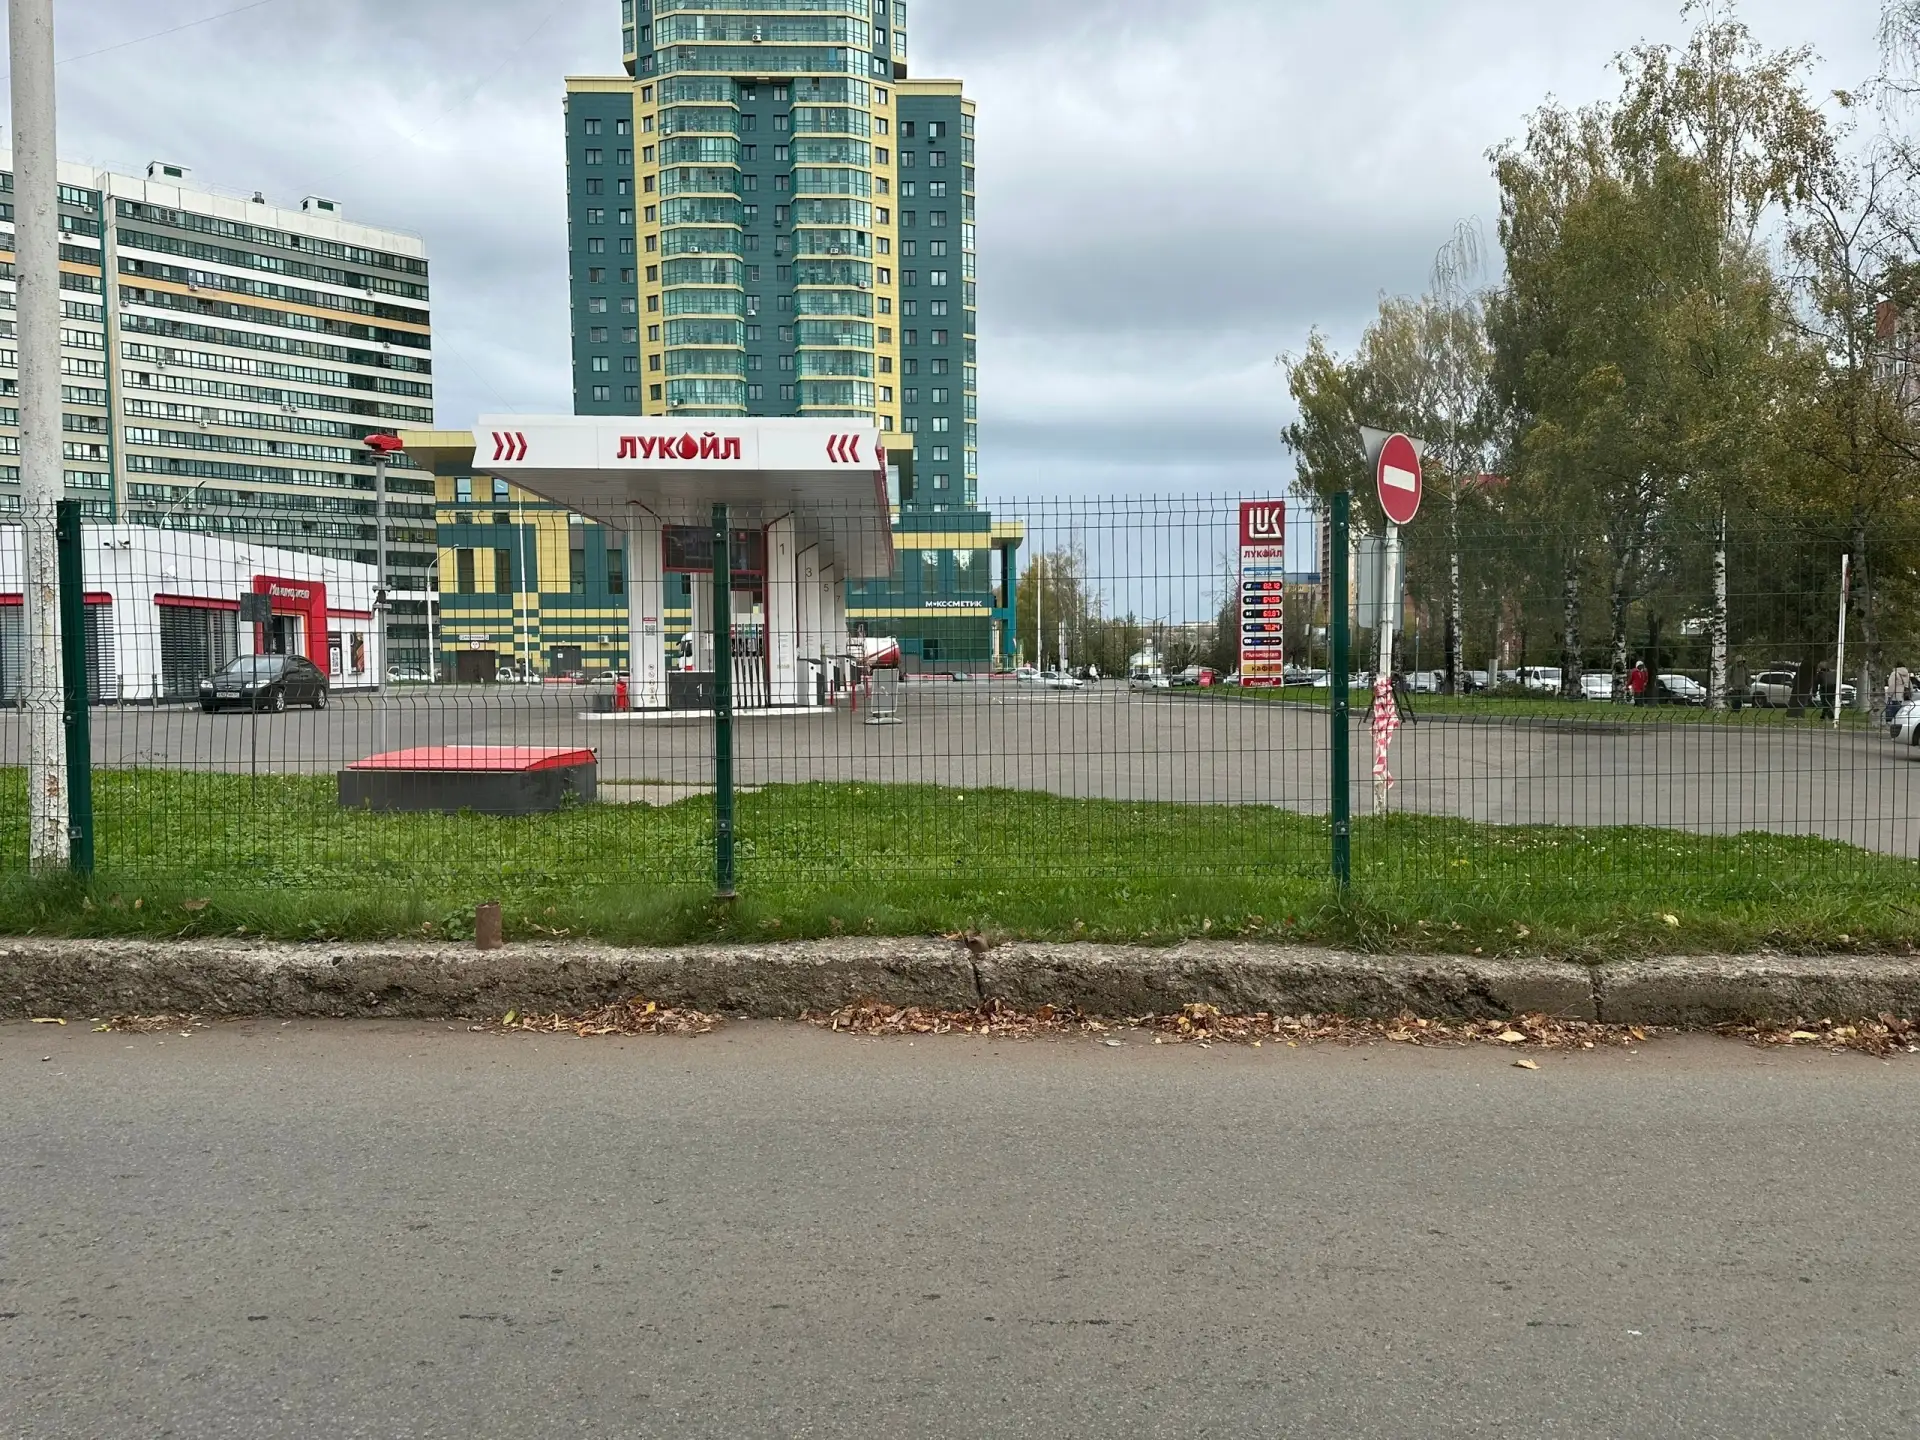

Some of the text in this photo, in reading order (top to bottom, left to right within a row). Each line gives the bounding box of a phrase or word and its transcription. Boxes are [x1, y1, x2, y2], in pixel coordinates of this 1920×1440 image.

[617, 431, 741, 460] ЛУКОЙЛ
[779, 543, 785, 555] 1
[1243, 549, 1282, 558] ЛУКОЙЛ
[805, 567, 812, 577] 3
[823, 584, 829, 592] 5
